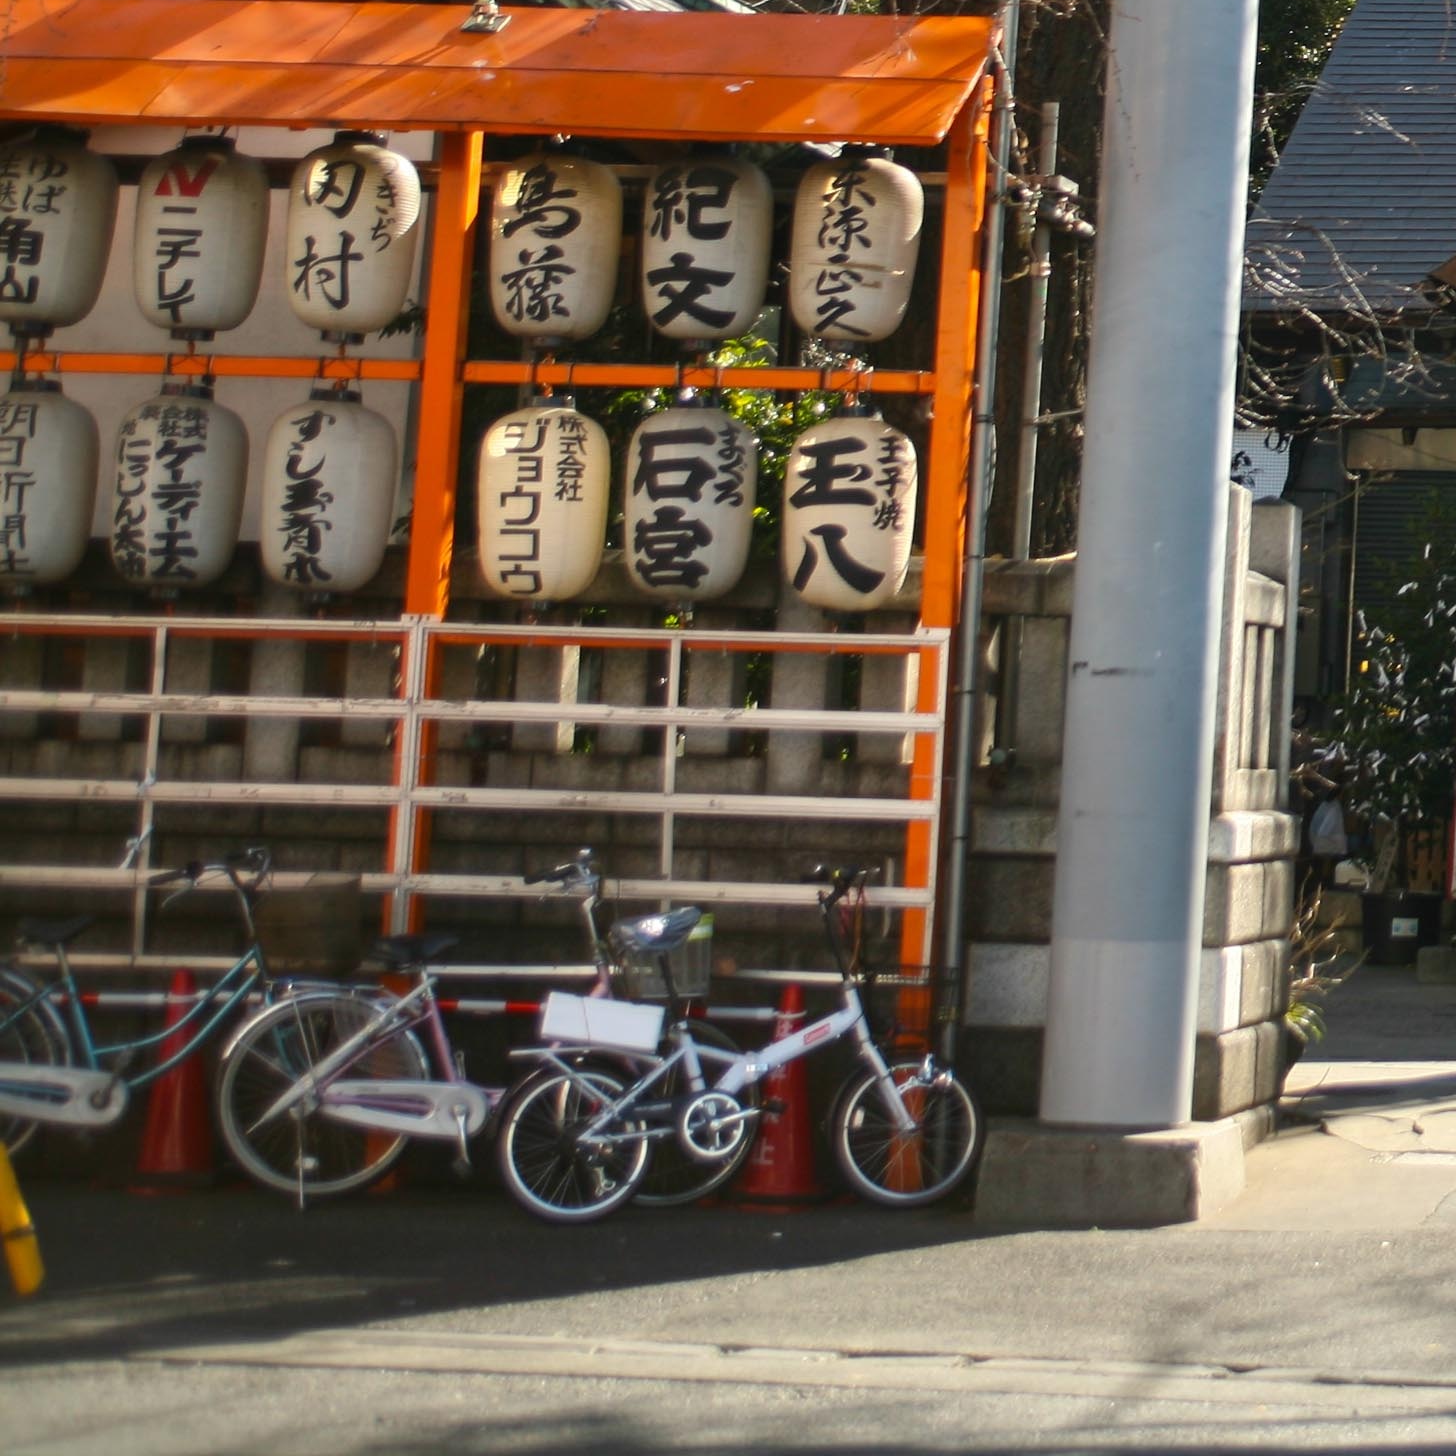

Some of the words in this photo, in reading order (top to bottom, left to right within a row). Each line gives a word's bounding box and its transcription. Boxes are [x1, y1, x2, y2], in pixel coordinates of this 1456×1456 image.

[155, 206, 203, 324] ニチレイ
[293, 160, 365, 311] 田村
[647, 167, 740, 329] 紀文
[149, 438, 207, 580] ケーディーエム
[498, 417, 551, 594] ジョウコウ
[554, 415, 589, 502] 株式会社
[632, 427, 718, 589] 石宮
[714, 423, 747, 507] まぐろ
[788, 436, 887, 594] 玉八
